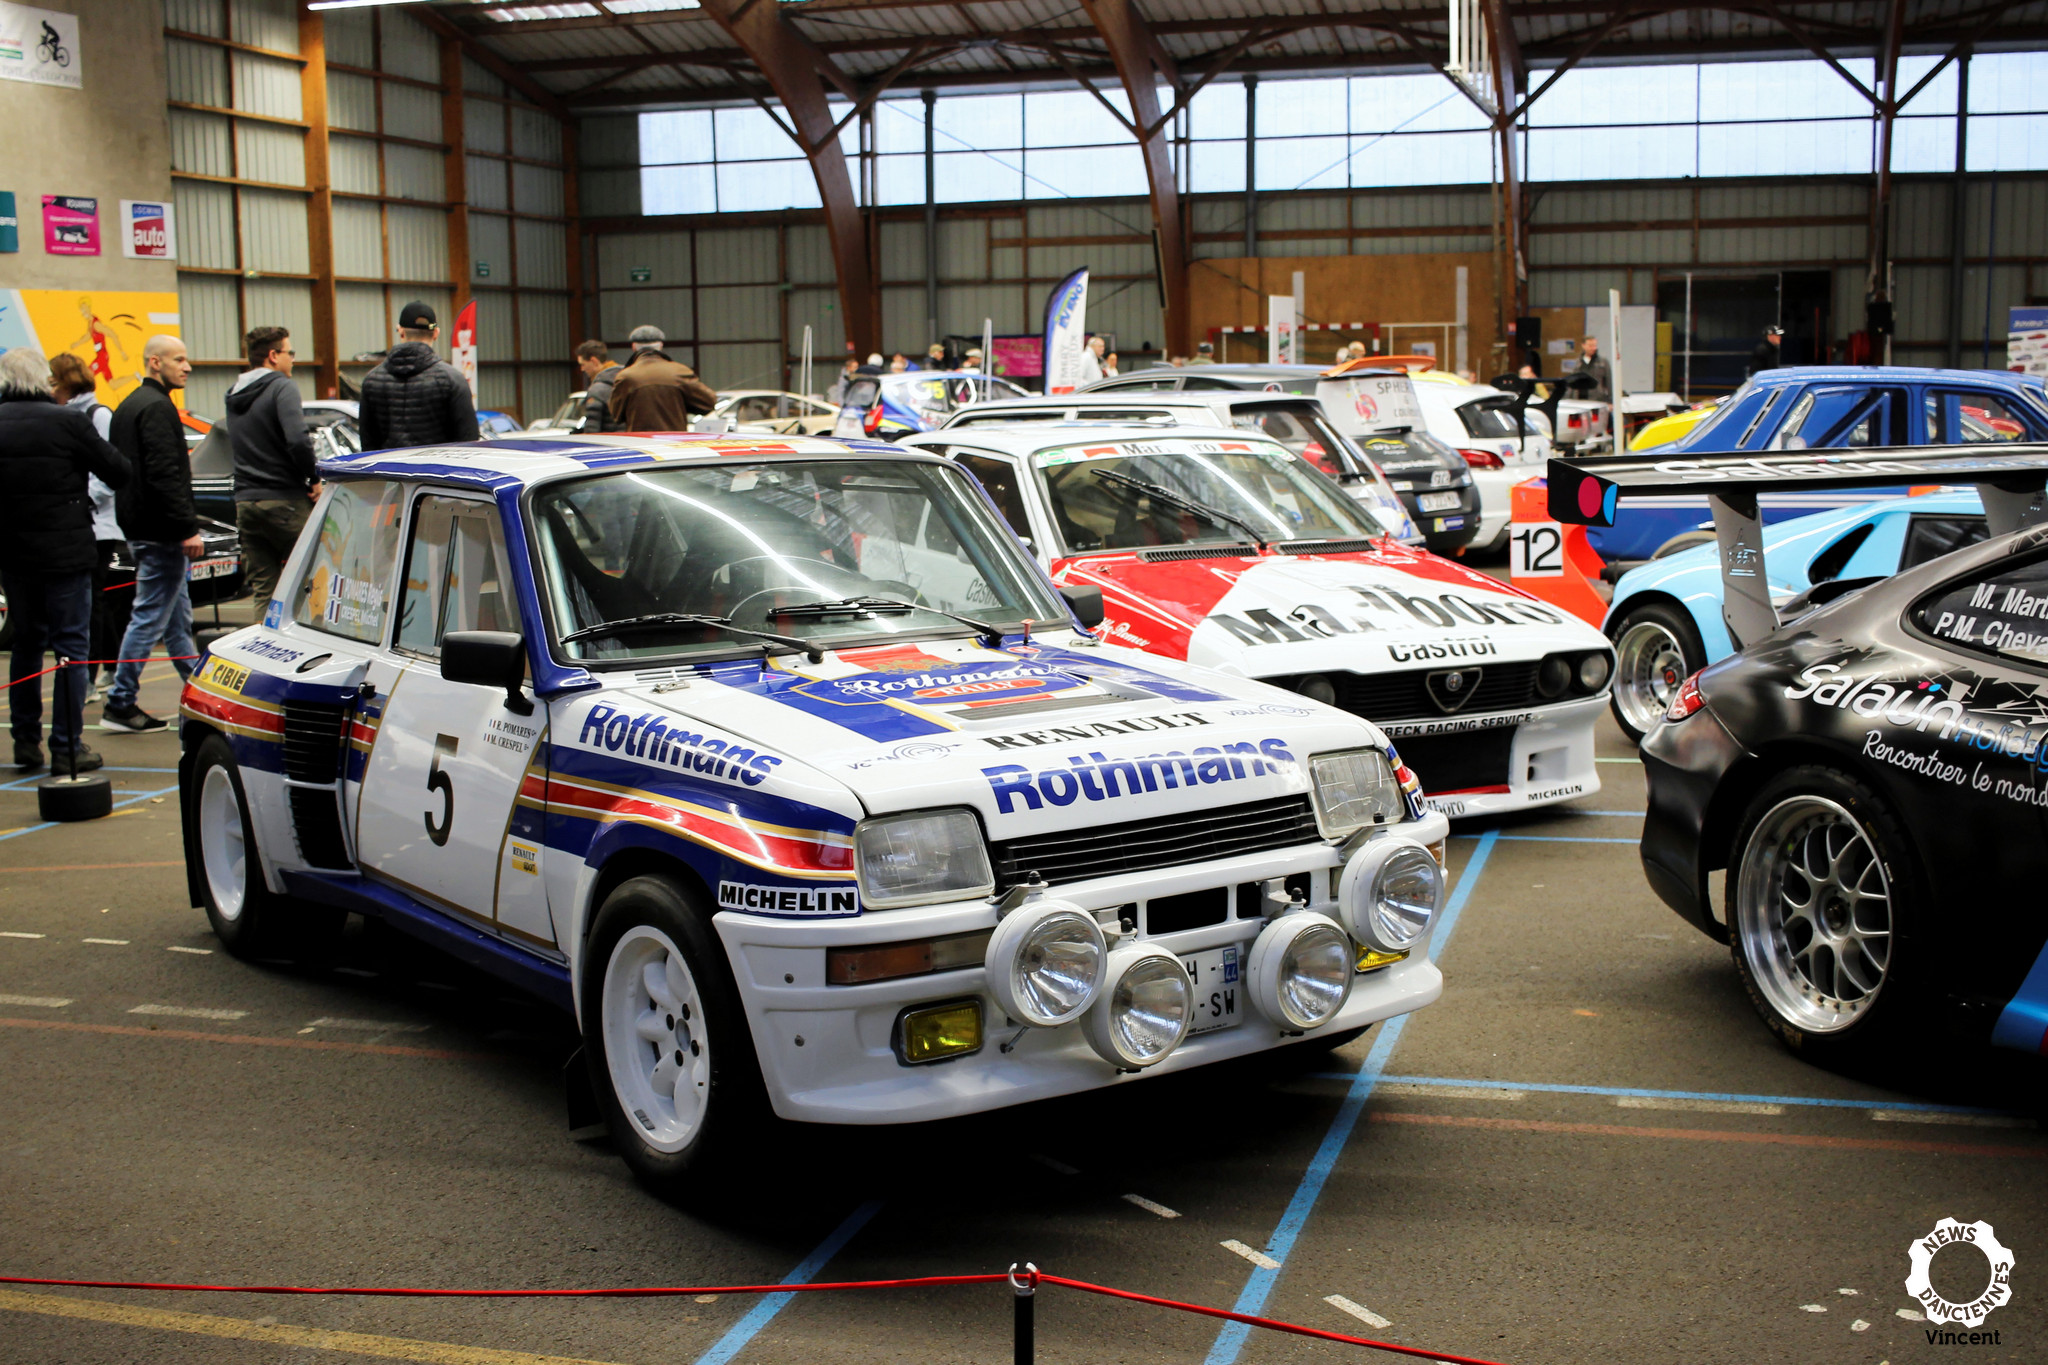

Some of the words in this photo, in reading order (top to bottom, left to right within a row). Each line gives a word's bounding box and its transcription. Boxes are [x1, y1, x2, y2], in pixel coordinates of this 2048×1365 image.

[134, 226, 165, 246] auto
[1122, 442, 1217, 456] Marro
[1512, 527, 1562, 571] 12
[1969, 582, 1996, 610] M.
[1933, 611, 1977, 643] P.M.
[942, 681, 1016, 696] RALLY
[503, 722, 531, 739] POMARES
[979, 711, 1214, 751] RENAULT
[1427, 720, 1476, 734] RACING
[1480, 713, 1532, 727] SERVICE
[498, 736, 523, 753] CRESPEL
[579, 701, 782, 786] Rothmans
[1862, 729, 1967, 785] Rencontrer
[1972, 761, 1993, 792] le
[980, 738, 1304, 814] Rothmans
[424, 733, 459, 847] 5
[1528, 784, 1583, 801] MICHELIN
[1427, 800, 1465, 816] lboro
[512, 846, 536, 862] RENAULT
[719, 884, 856, 911] MICHELIN
[1225, 966, 1237, 980] 44
